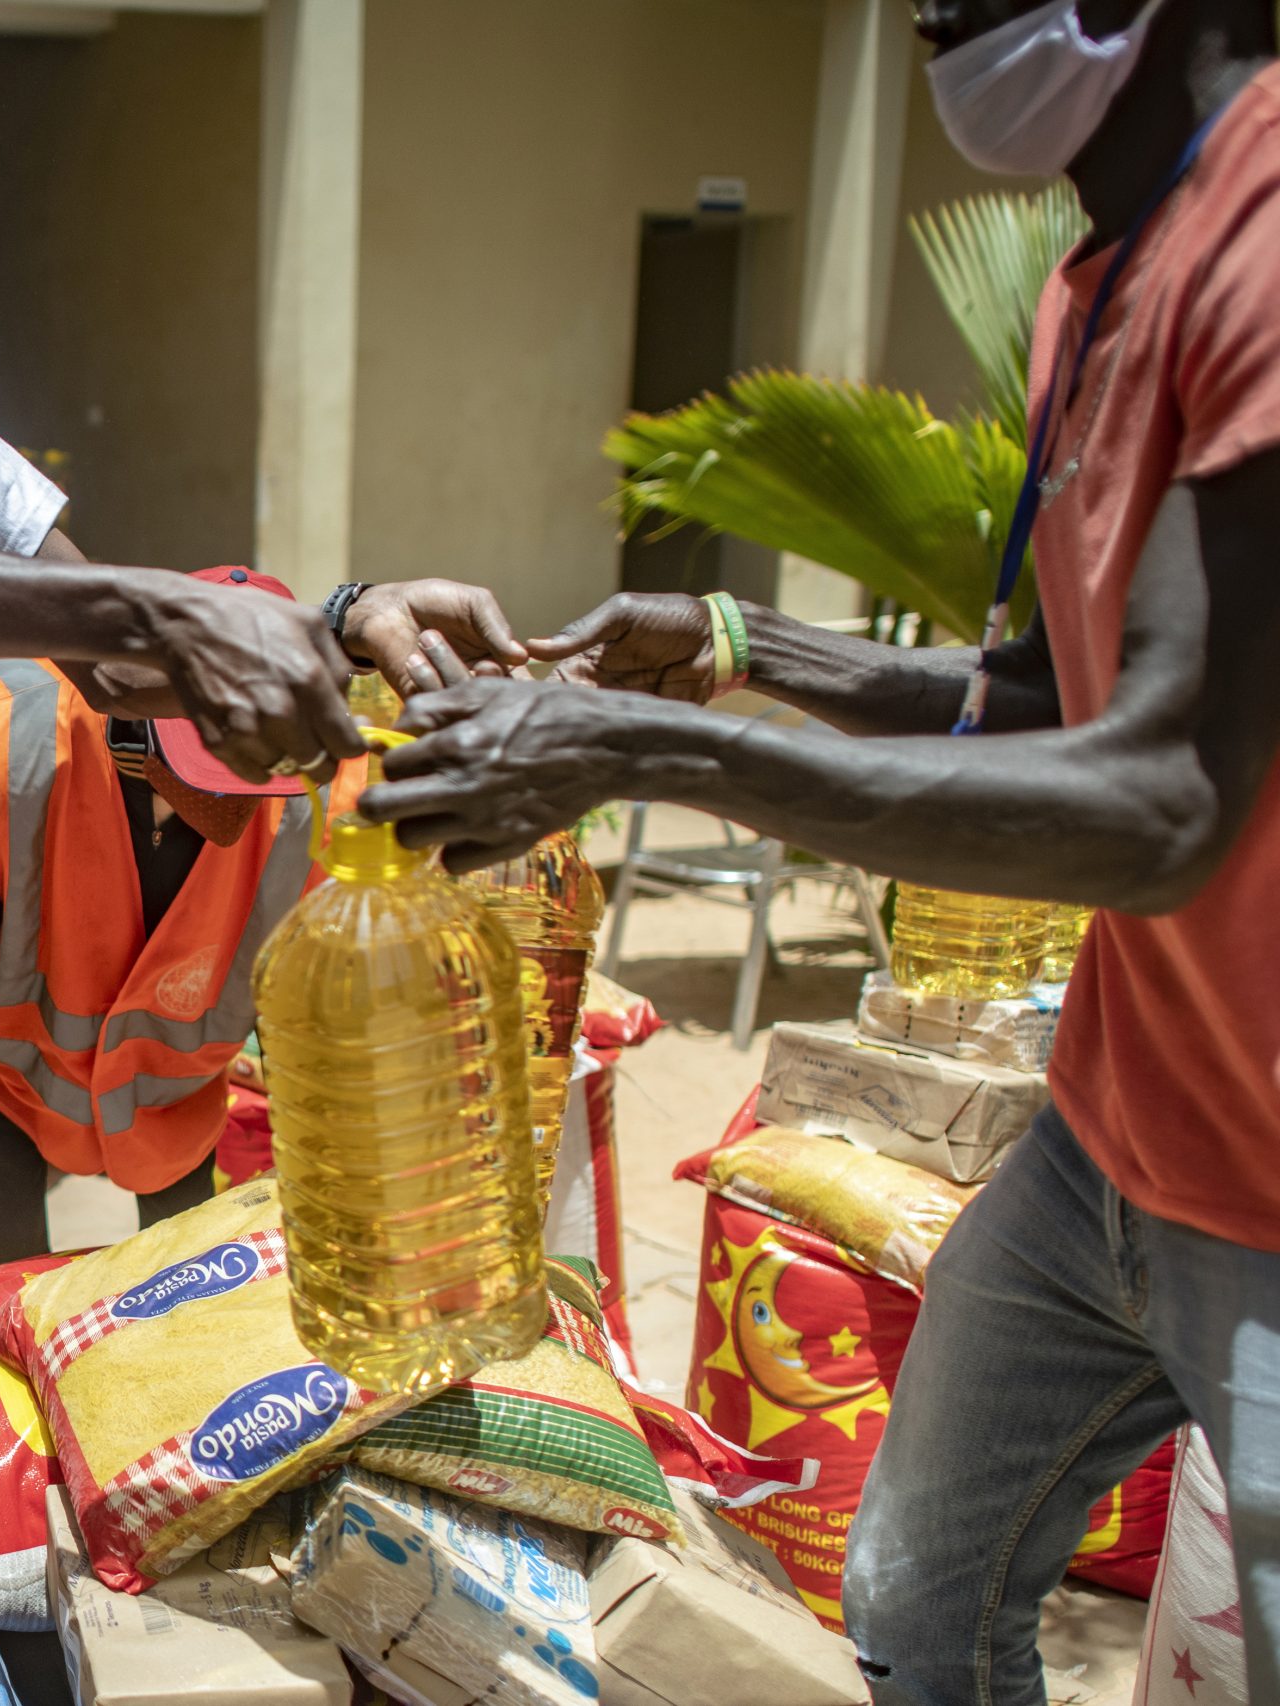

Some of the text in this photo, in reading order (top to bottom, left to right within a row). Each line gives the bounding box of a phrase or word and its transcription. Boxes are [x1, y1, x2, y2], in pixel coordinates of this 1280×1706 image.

[120, 1248, 247, 1309] Mondo
[154, 1270, 200, 1300] pasta
[198, 1371, 337, 1461] Mondo
[240, 1407, 290, 1450] pasta
[607, 1512, 655, 1538] Mis
[770, 1494, 822, 1523] LONG
[757, 1511, 847, 1553] BRISURES
[793, 1549, 845, 1576] 50KG
